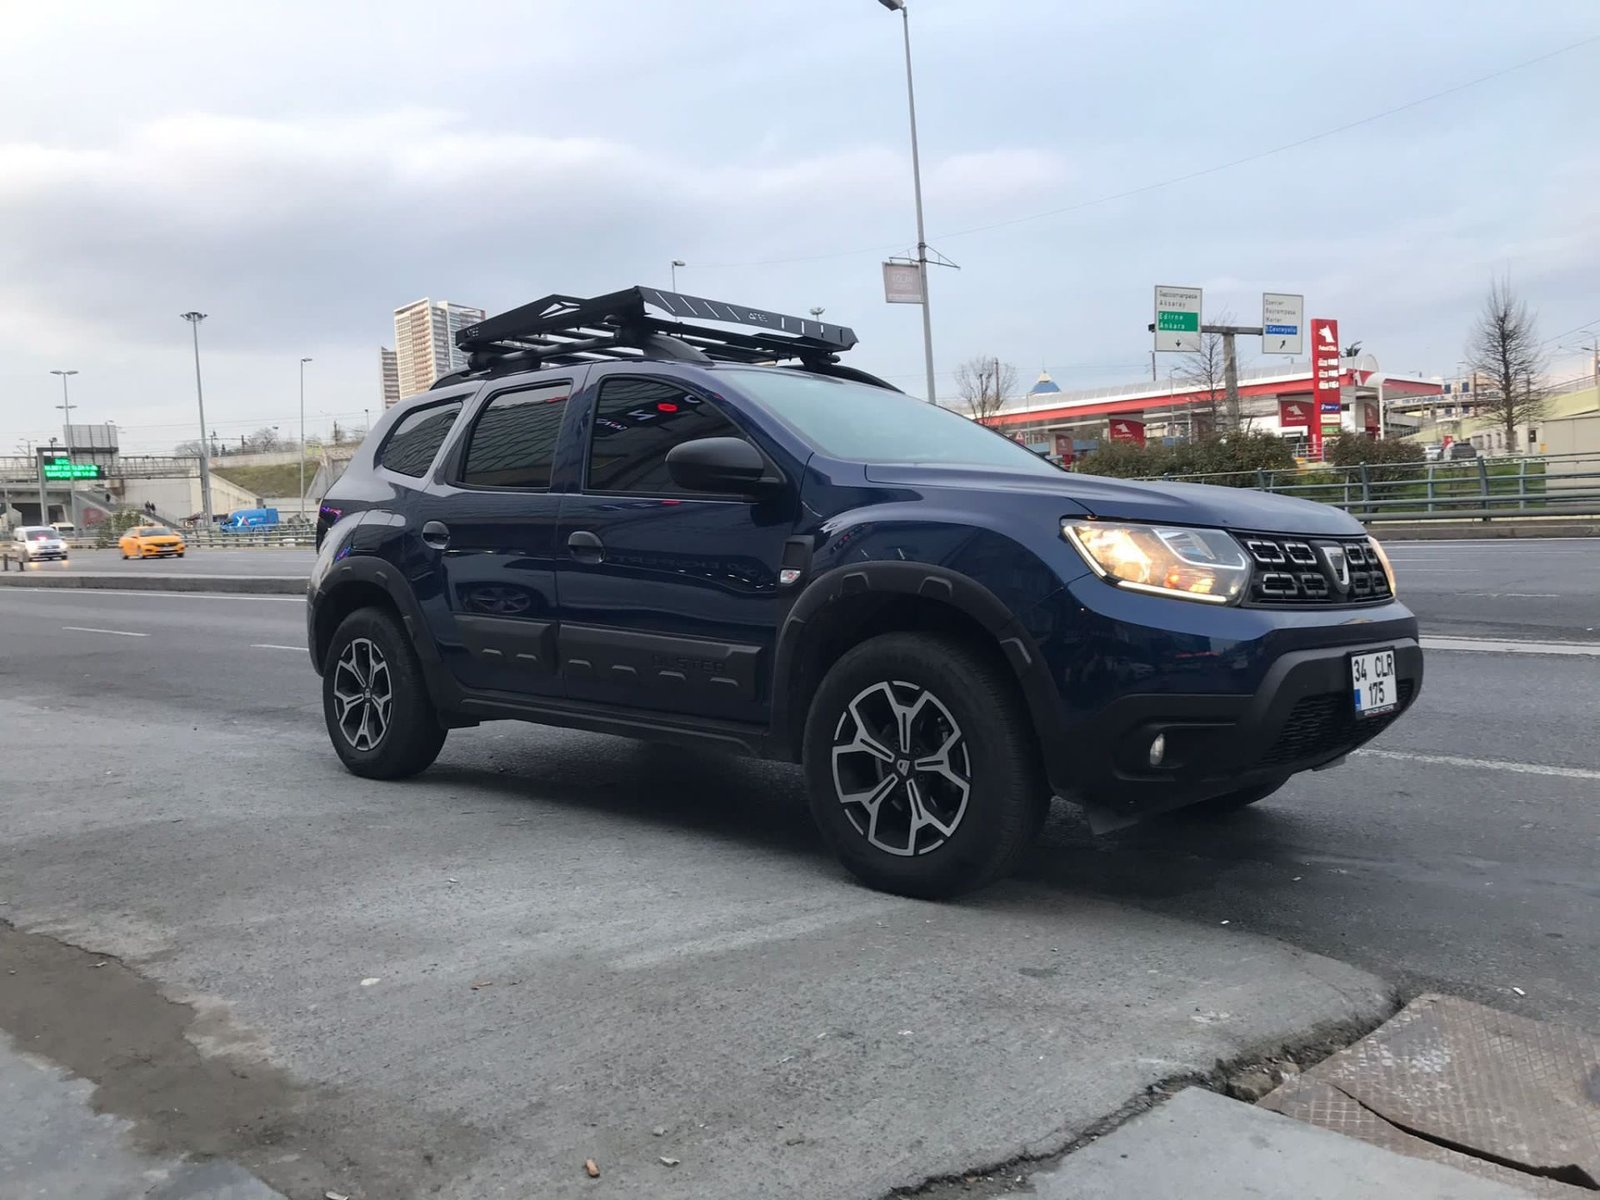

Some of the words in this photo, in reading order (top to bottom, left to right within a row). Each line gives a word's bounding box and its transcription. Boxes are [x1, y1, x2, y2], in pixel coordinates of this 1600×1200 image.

[1159, 312, 1183, 320] Edirne
[1159, 321, 1185, 330] Ankara
[1354, 658, 1367, 682] 34
[1375, 653, 1394, 678] CLR
[1368, 681, 1386, 706] 175
